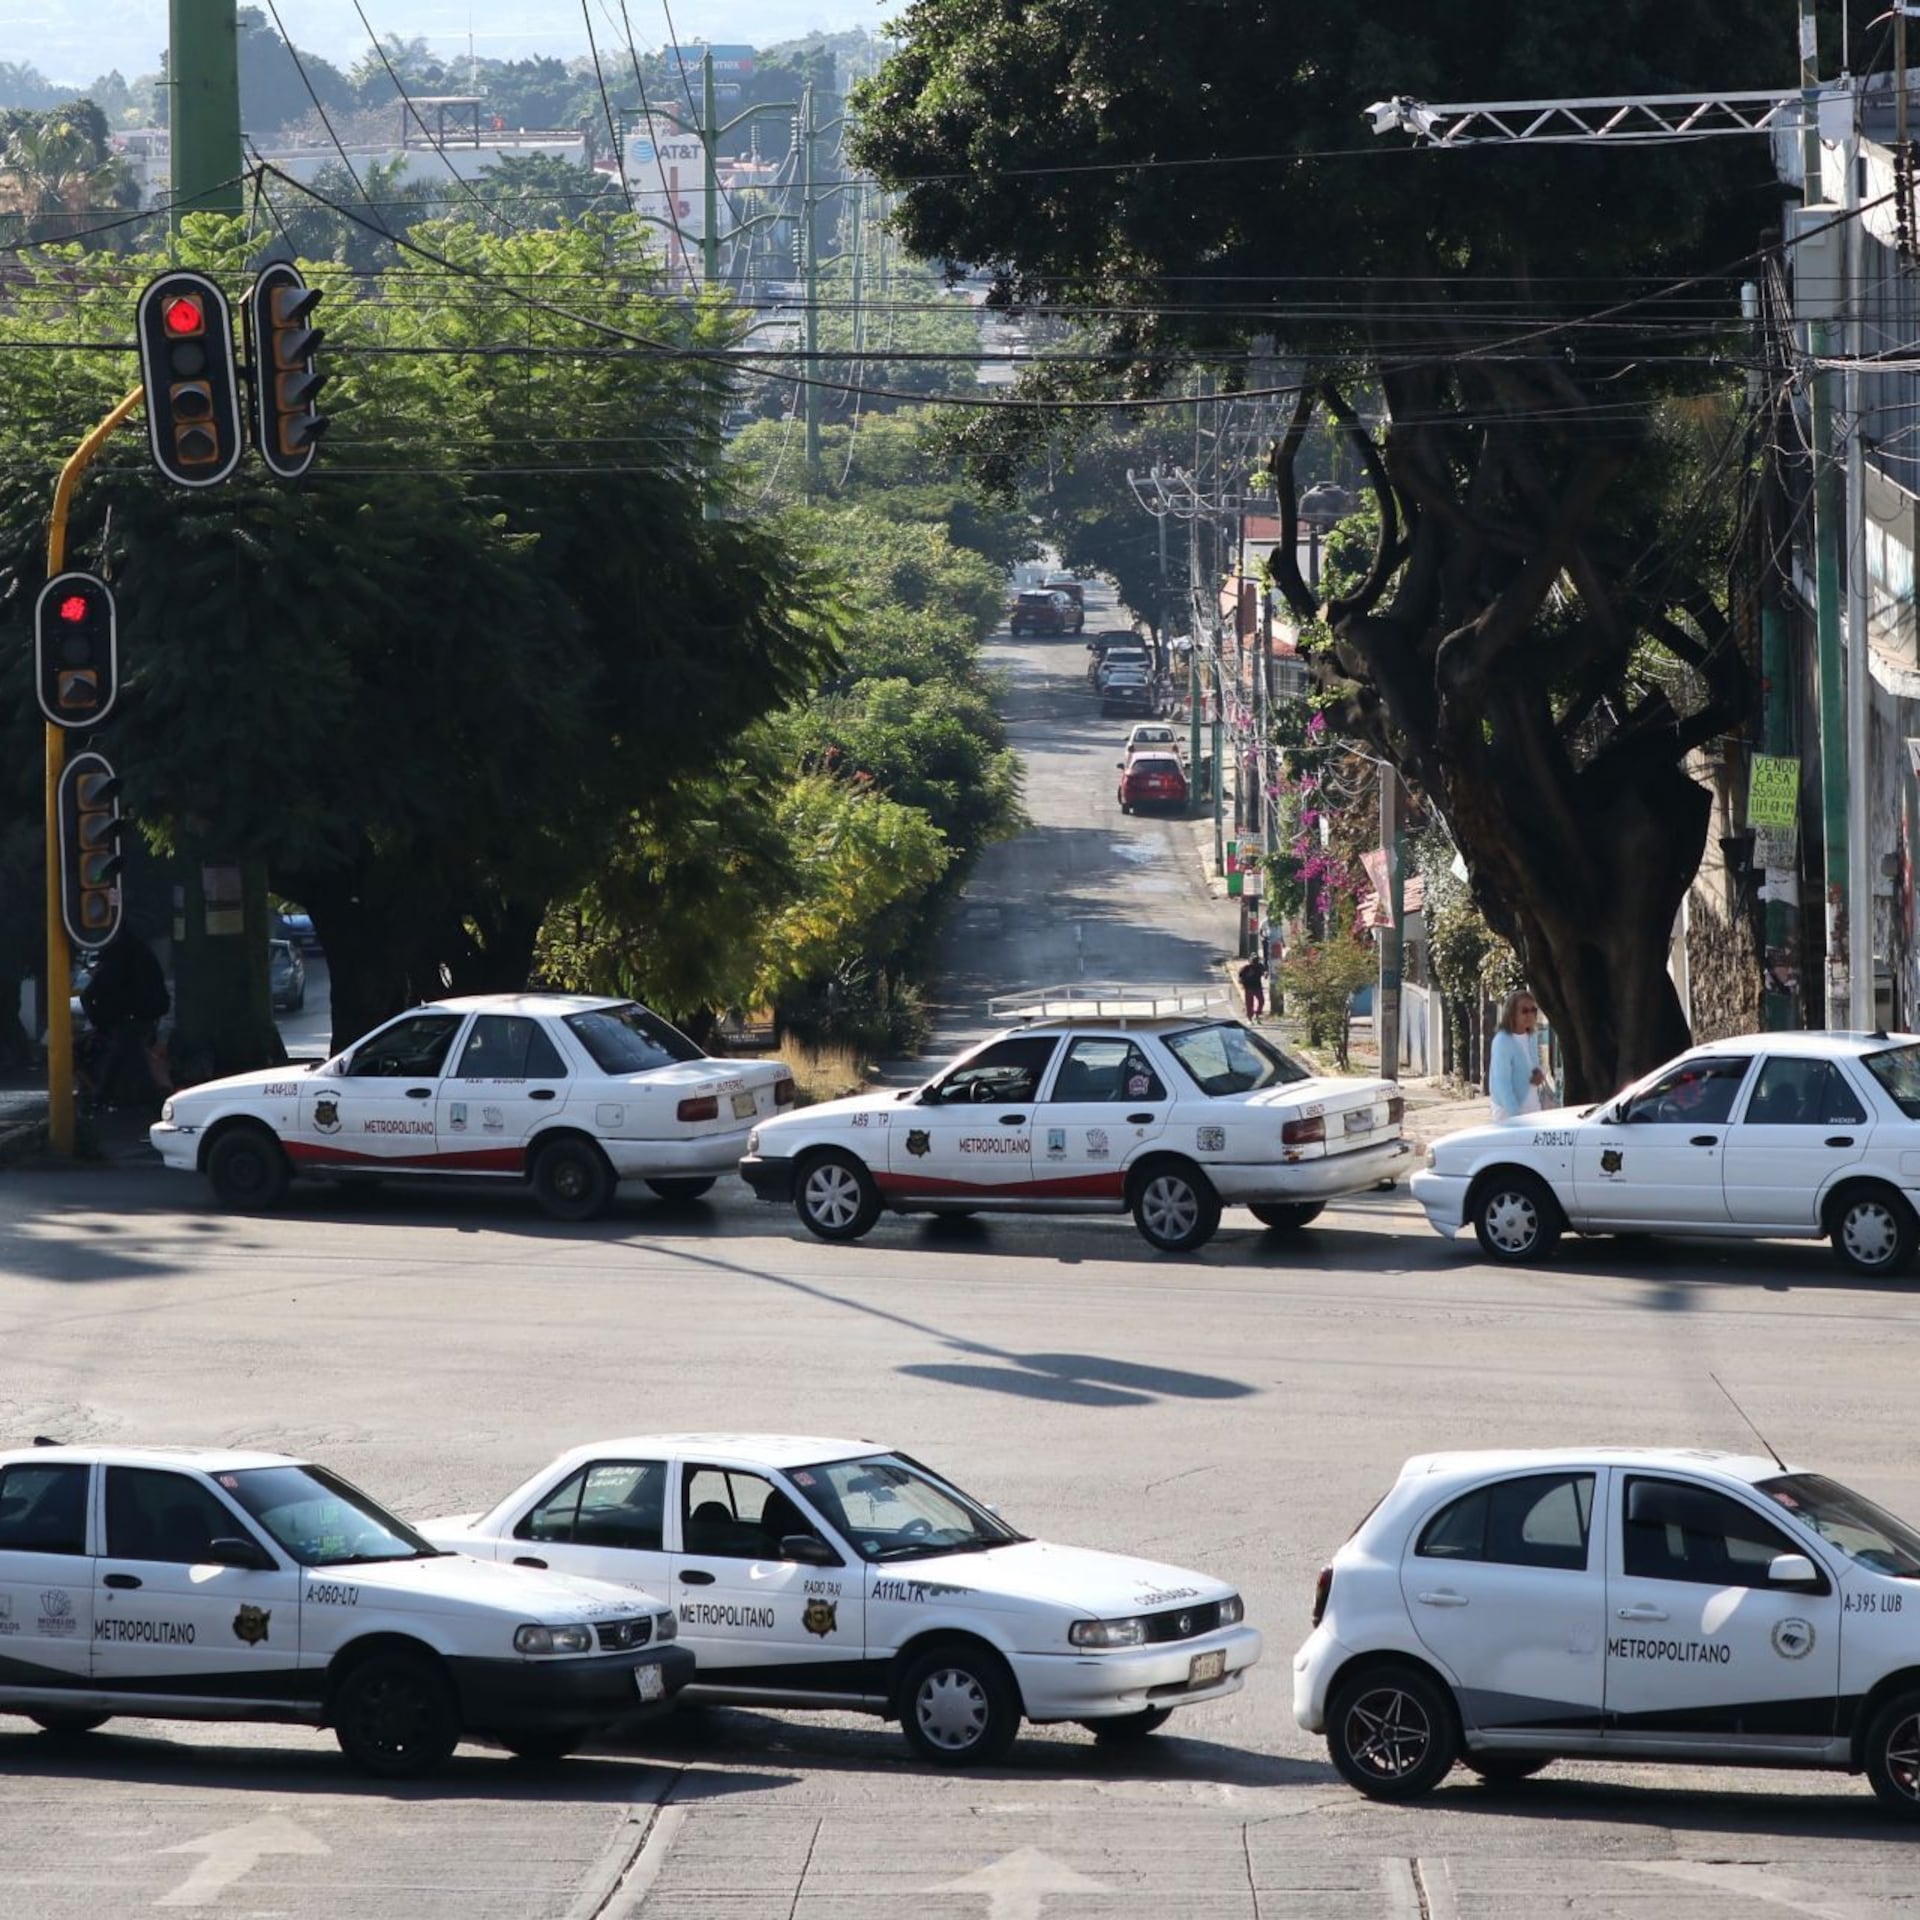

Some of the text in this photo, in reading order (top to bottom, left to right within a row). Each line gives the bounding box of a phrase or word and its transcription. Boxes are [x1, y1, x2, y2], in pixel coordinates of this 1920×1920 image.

[659, 144, 701, 160] AT&T
[1754, 758, 1797, 773] VENDO
[1756, 771, 1791, 785] CASA
[364, 1120, 434, 1135] METROPOLITANO
[852, 1113, 890, 1127] A89 TP
[959, 1138, 1030, 1153] METROPOLITANO
[1533, 1132, 1574, 1146] A-708-LTU
[306, 1584, 359, 1605] A-060-LTJ
[803, 1580, 842, 1596] RADIO TAXI
[1843, 1593, 1902, 1613] A-395 LUB
[679, 1603, 776, 1629] METROPOLITANO
[94, 1619, 196, 1644] METROPOLITANO
[1607, 1637, 1732, 1665] METROPOLITANO
